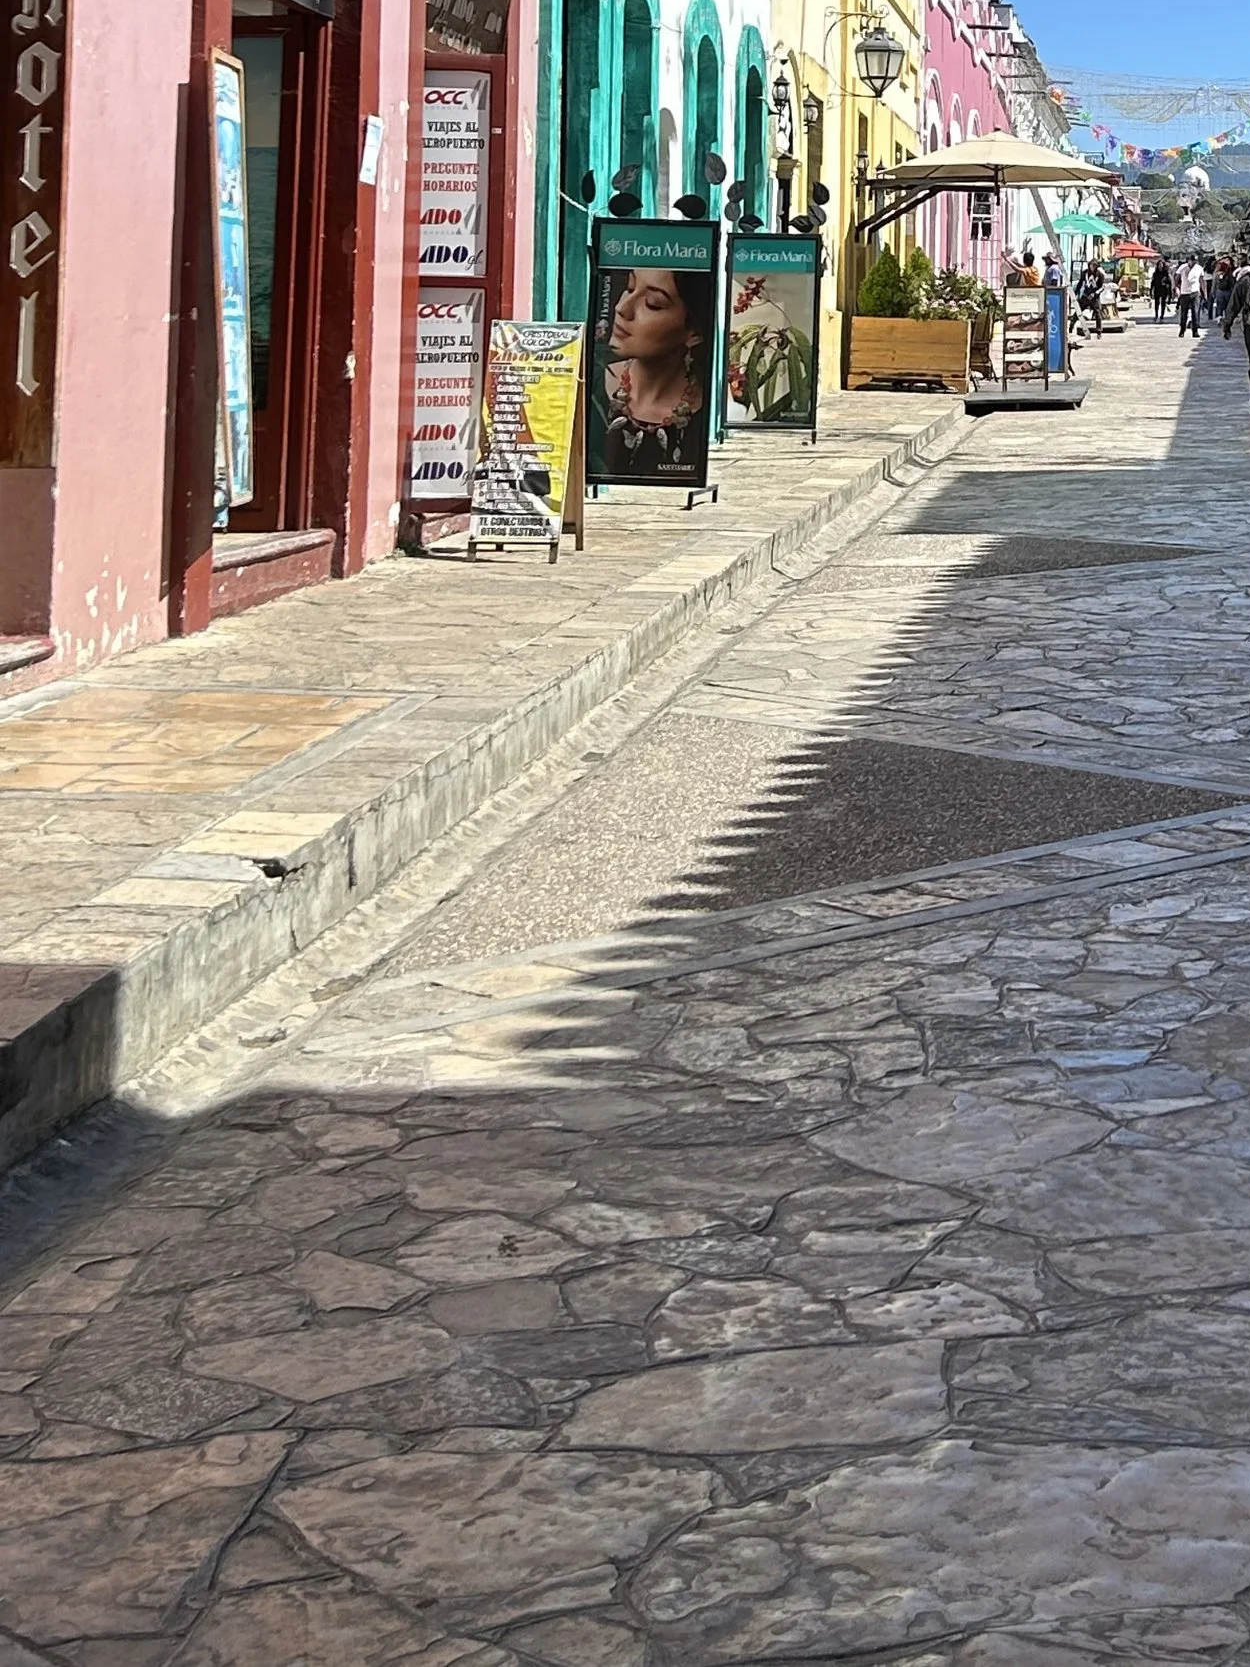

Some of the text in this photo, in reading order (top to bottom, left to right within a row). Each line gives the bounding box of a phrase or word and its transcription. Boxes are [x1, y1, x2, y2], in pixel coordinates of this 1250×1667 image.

[424, 90, 468, 105] OCC
[427, 121, 479, 135] VIAJES AL
[422, 138, 485, 150] AEROPUERTO
[423, 163, 480, 175] PREGUNTE
[422, 181, 477, 192] HORARIOS
[420, 208, 462, 225] ADO
[418, 245, 469, 264] ADO
[623, 240, 707, 258] Flora María
[750, 249, 779, 262] Flora
[418, 304, 461, 319] OCC
[421, 336, 473, 350] VIAJES AL
[415, 352, 480, 364] AEROPUERTO
[417, 377, 475, 390] PREGUNTE
[417, 395, 472, 408] HORARIOS
[413, 424, 457, 441] ADO
[412, 461, 464, 480] ADO
